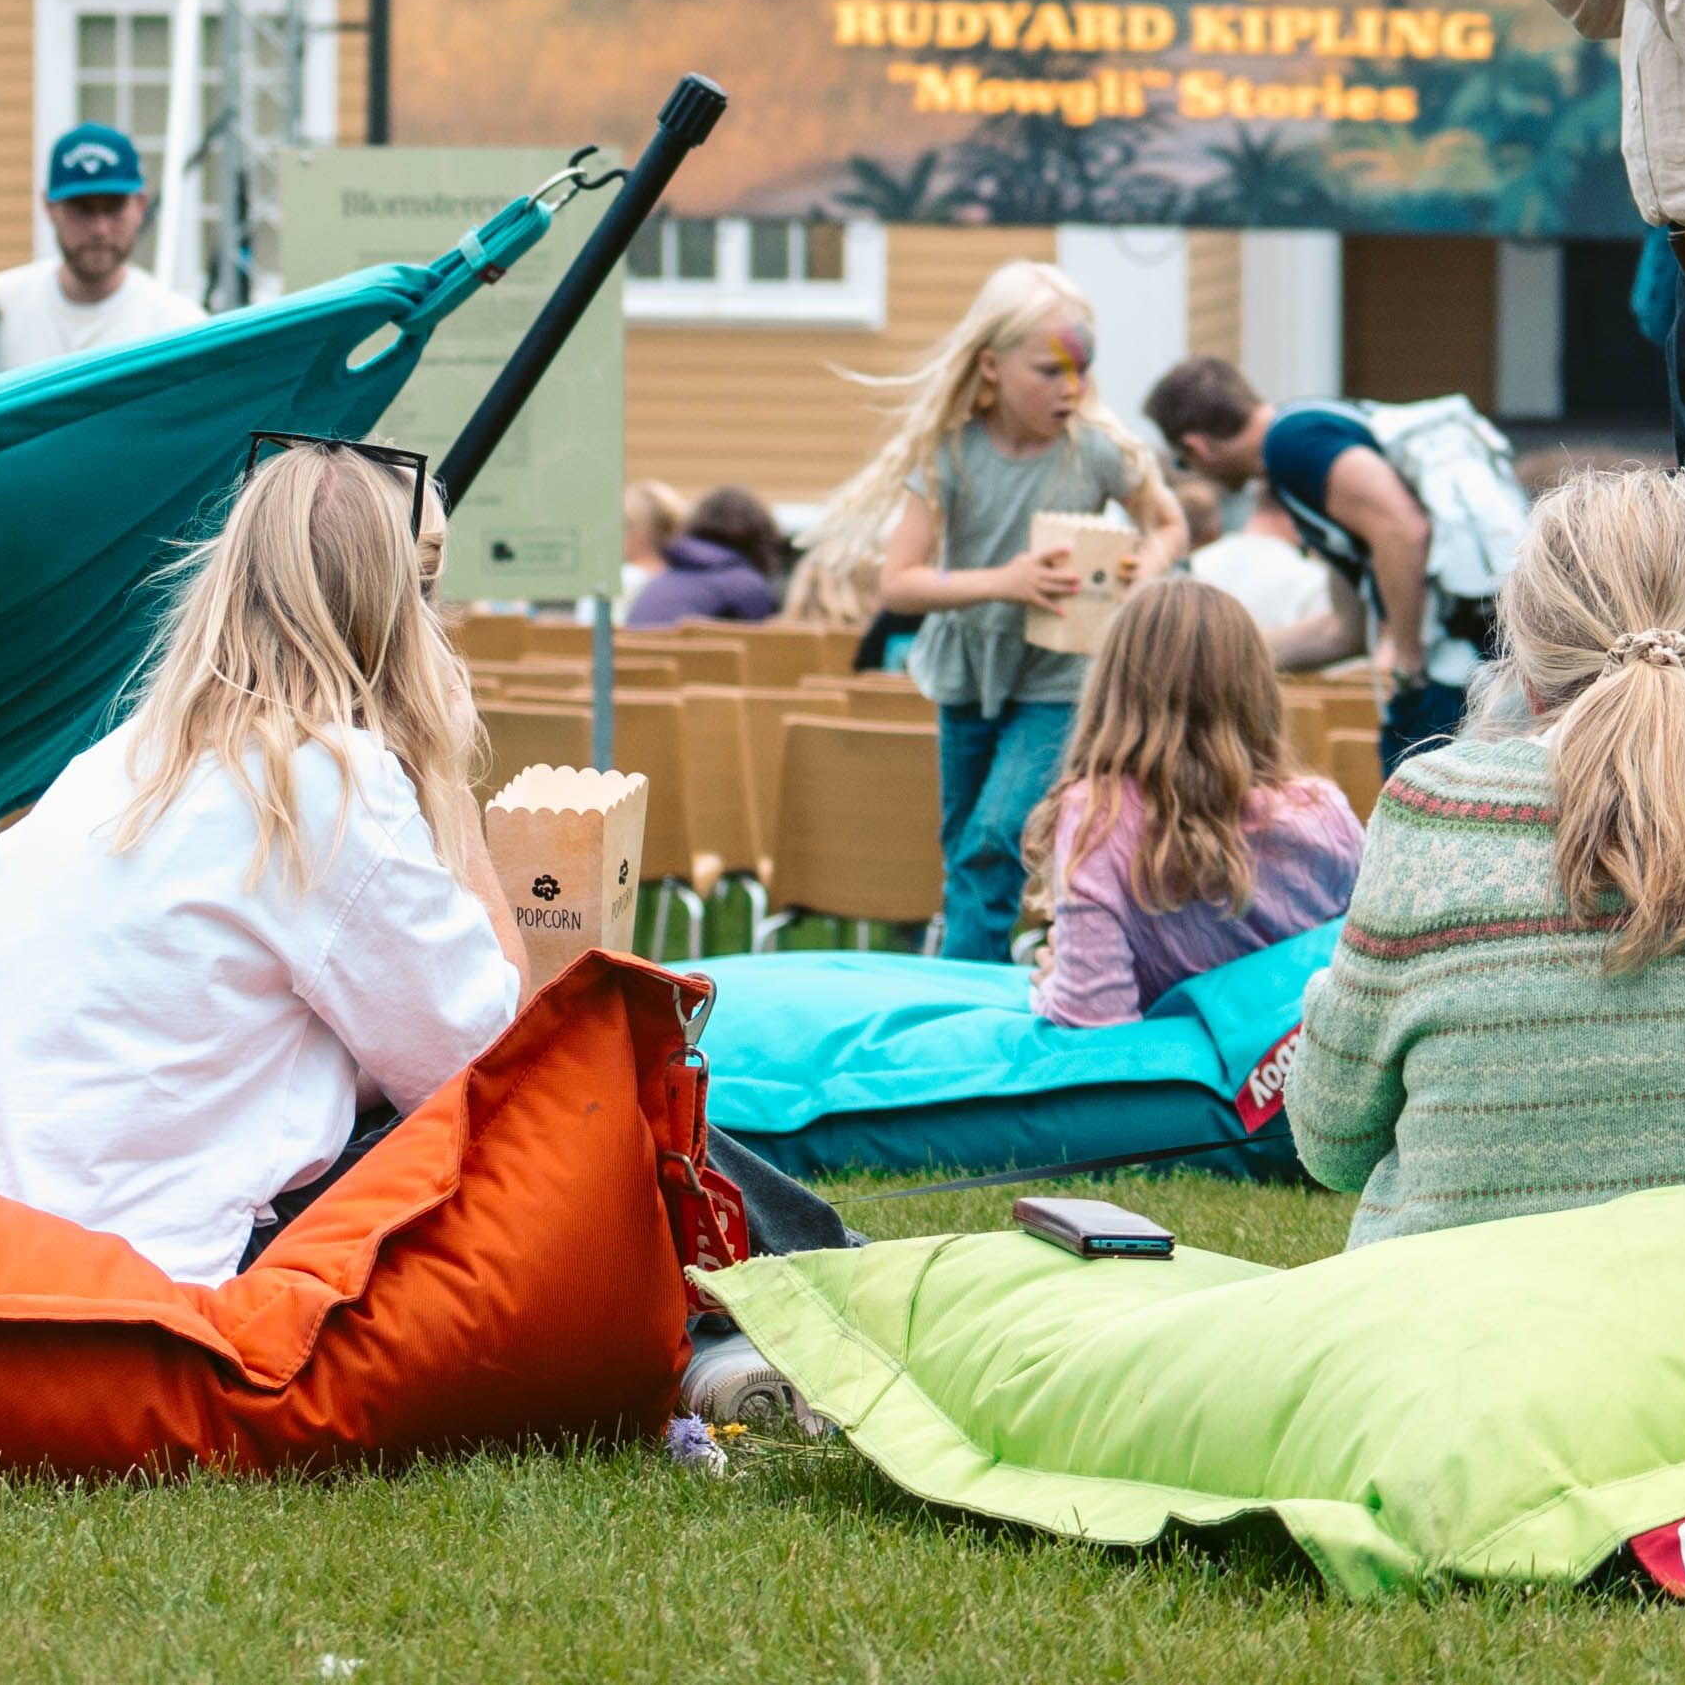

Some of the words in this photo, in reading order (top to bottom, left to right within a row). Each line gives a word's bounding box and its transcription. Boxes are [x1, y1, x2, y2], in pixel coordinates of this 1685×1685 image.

[833, 0, 1176, 53] RUDYARD
[1190, 6, 1496, 60] KIPLING
[886, 63, 1172, 127] "Mowgli"
[1178, 69, 1419, 122] Stories
[516, 907, 582, 931] POPCORN
